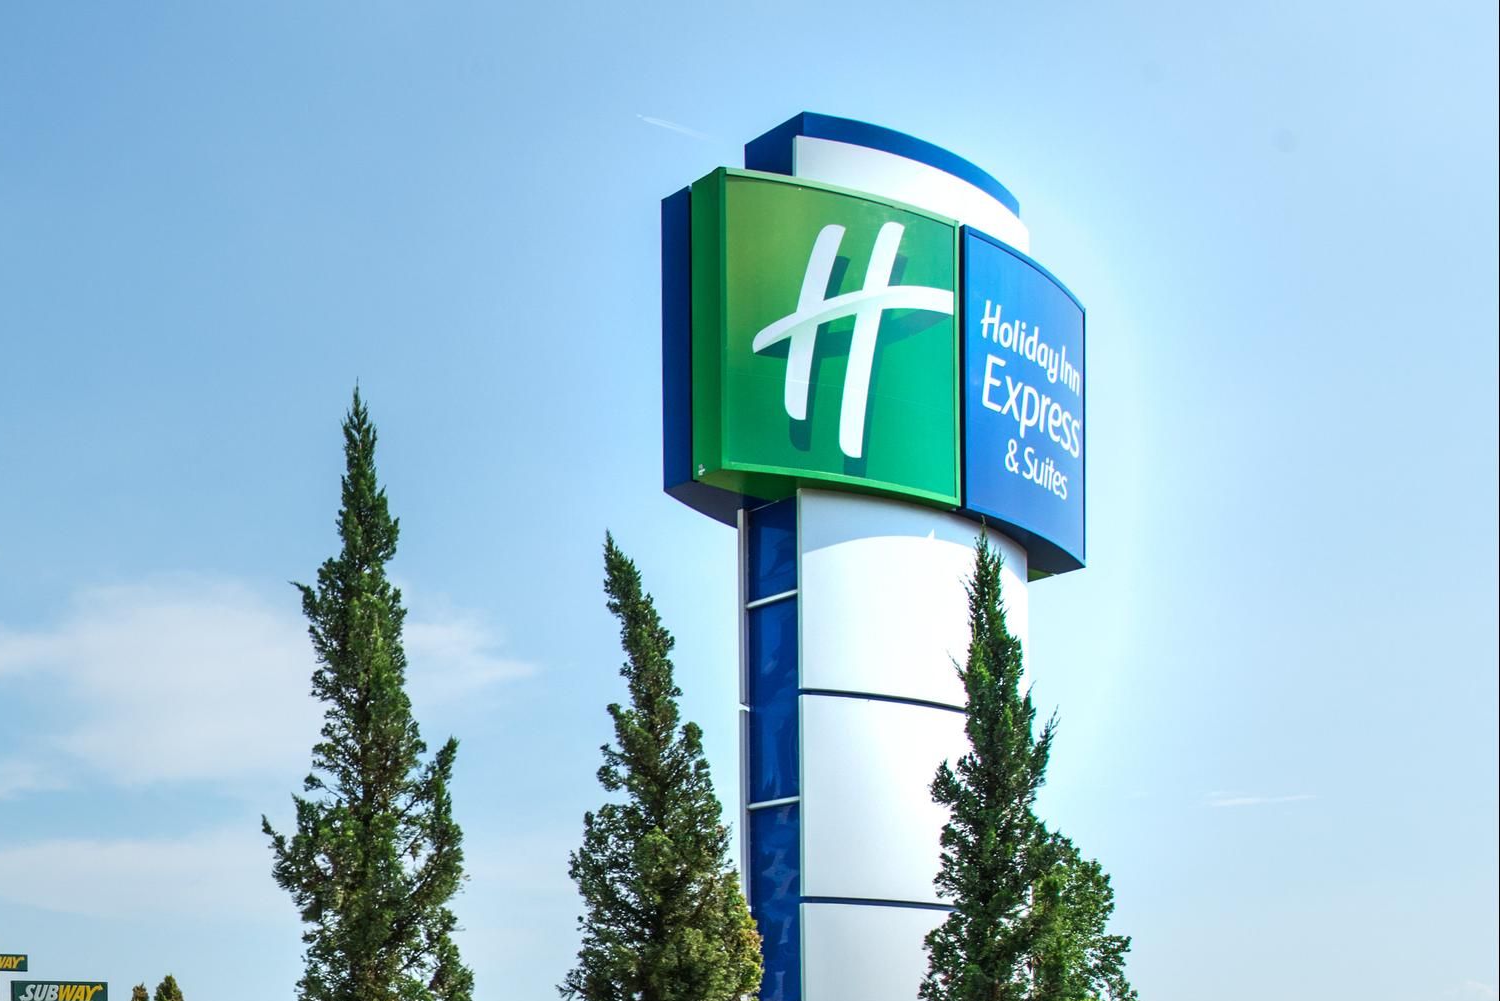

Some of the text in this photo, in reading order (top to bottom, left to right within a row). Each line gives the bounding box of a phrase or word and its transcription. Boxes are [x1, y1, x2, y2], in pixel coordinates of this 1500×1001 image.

[980, 299, 1080, 396] Holiday Inn
[982, 353, 1080, 458] Express
[1005, 439, 1068, 500] & Suites
